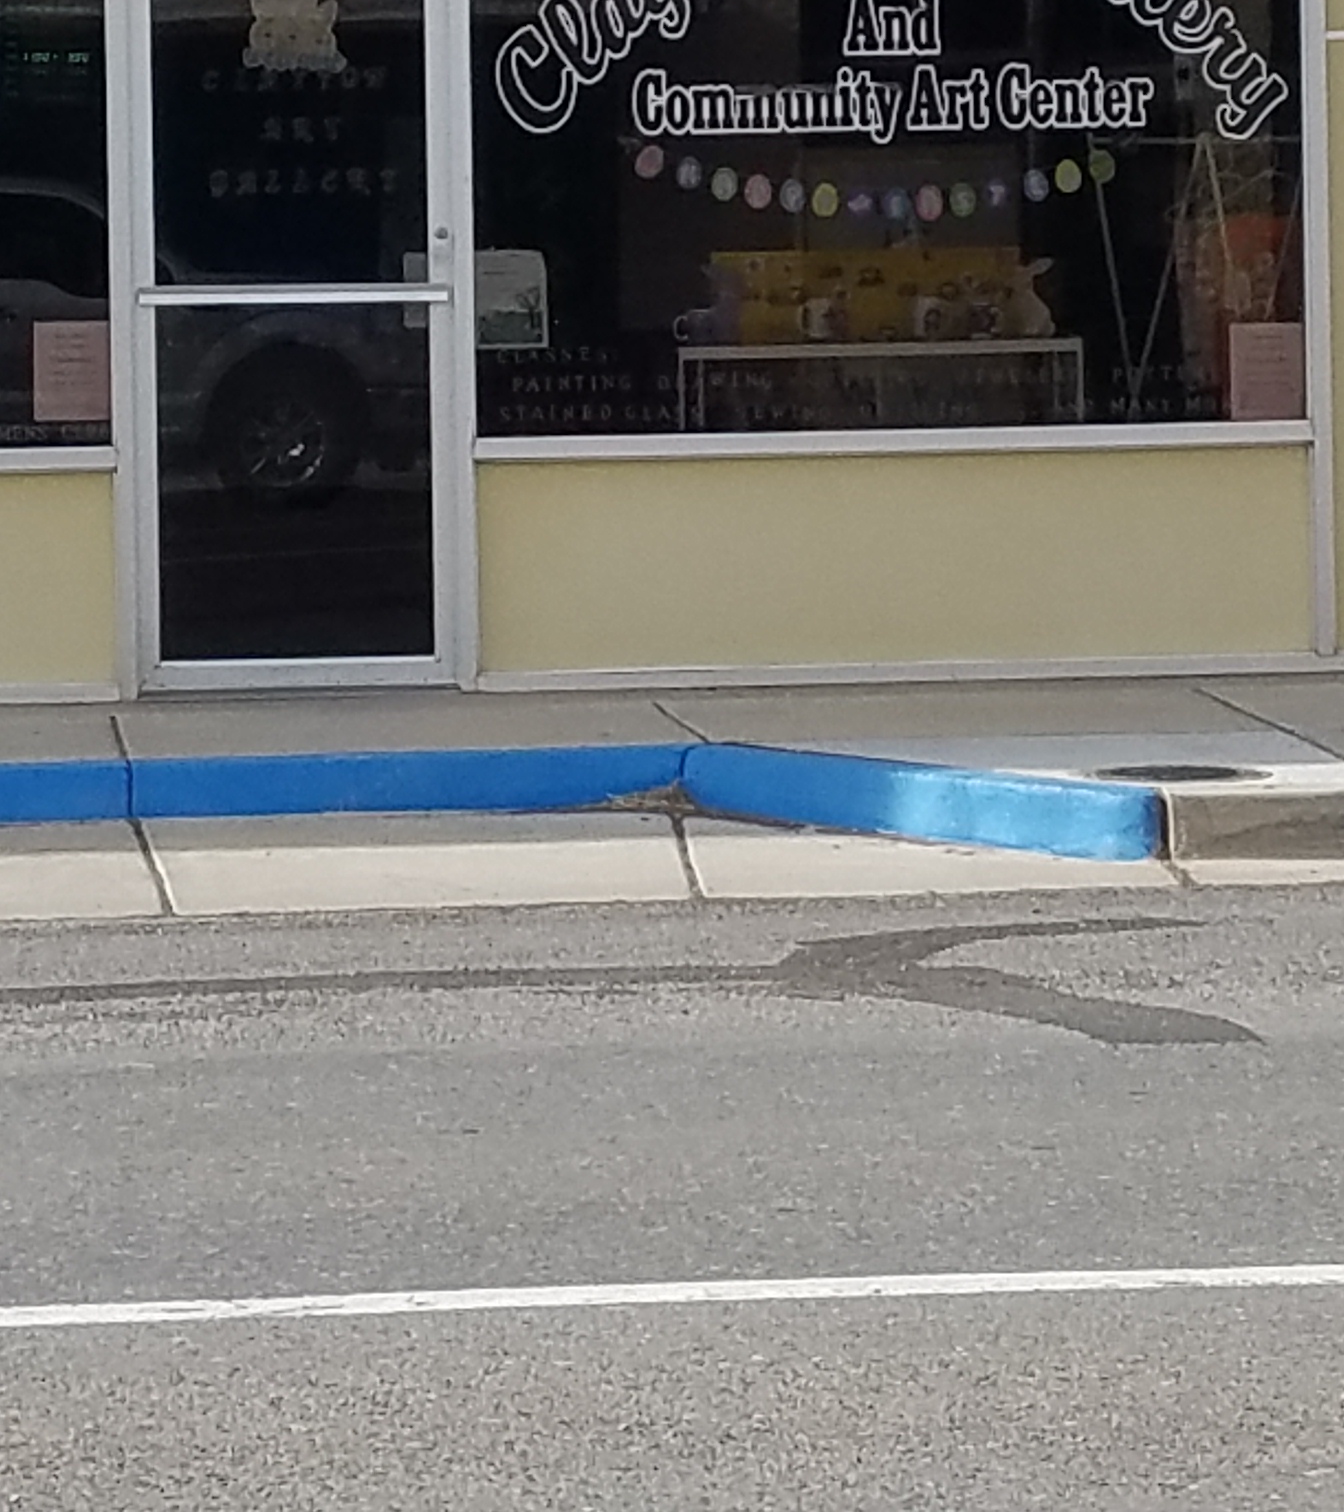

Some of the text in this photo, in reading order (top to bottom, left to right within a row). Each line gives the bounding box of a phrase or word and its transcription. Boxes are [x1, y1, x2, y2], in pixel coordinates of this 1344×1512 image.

[632, 62, 1154, 146] Community Art Center
